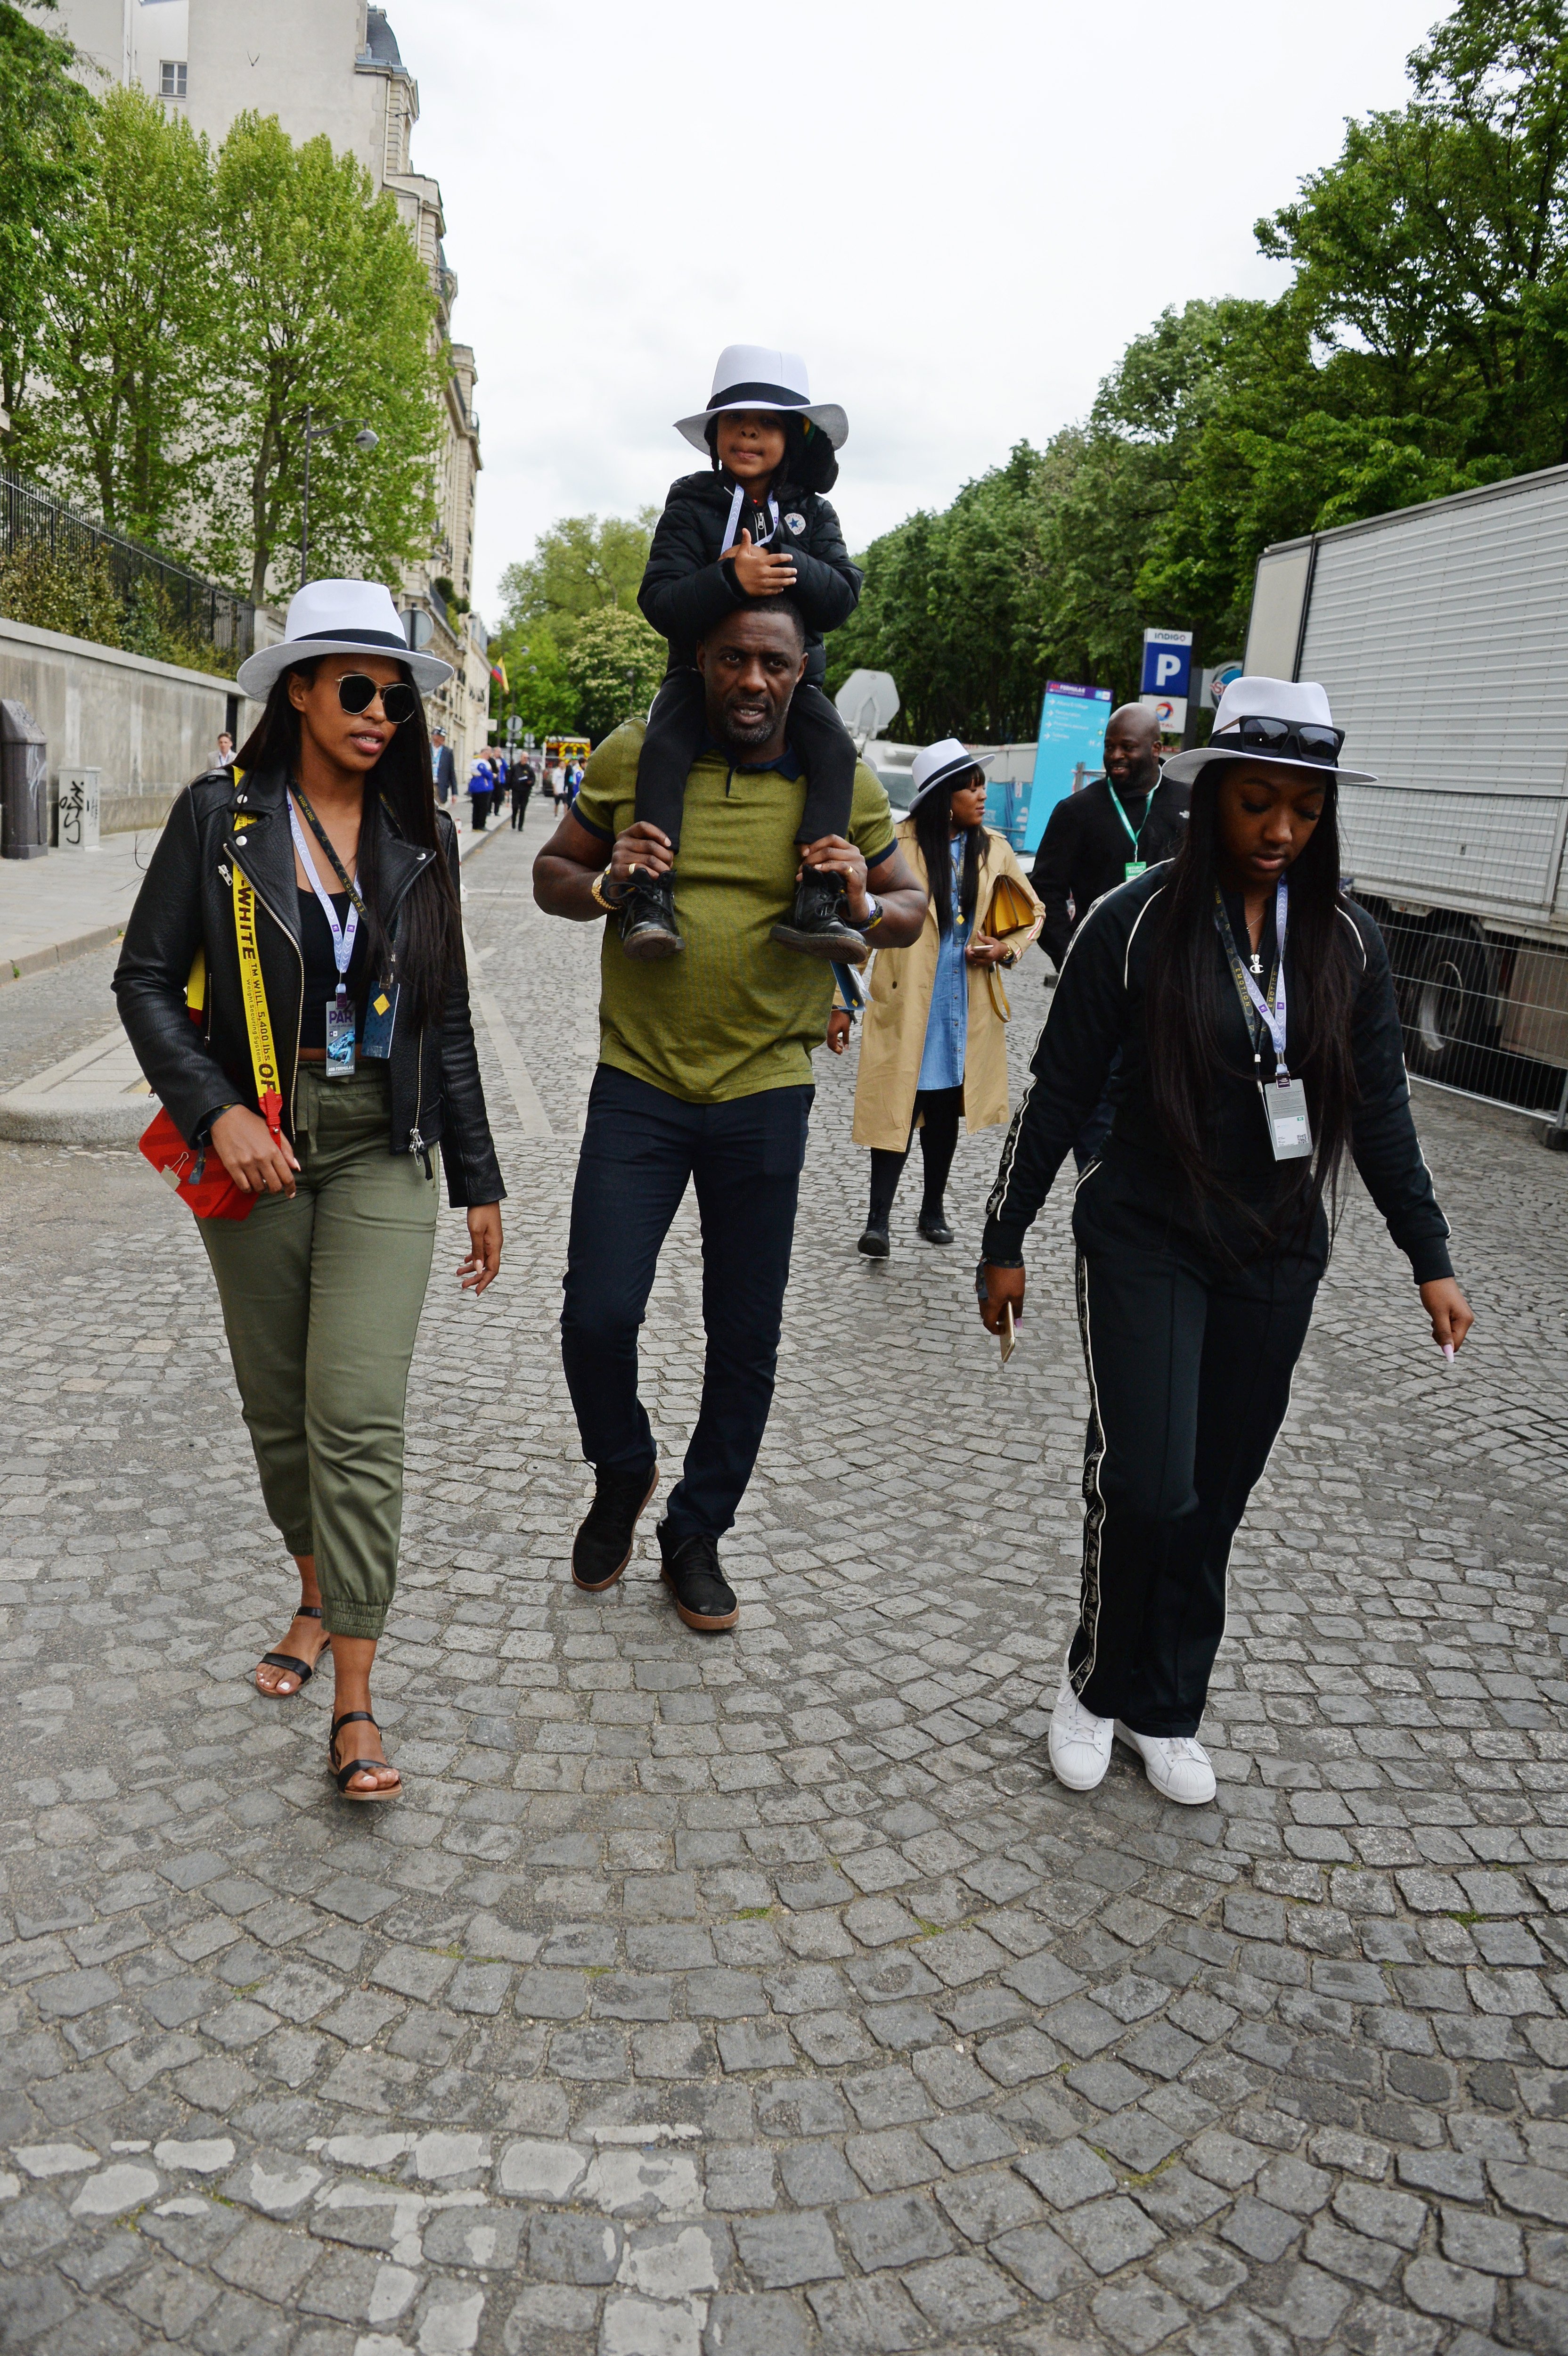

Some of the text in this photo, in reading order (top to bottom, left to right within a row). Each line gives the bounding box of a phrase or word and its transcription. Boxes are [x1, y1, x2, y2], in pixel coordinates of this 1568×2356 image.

[1155, 653, 1182, 687] P
[253, 980, 263, 1006] WILL
[257, 1011, 269, 1041] 5,400
